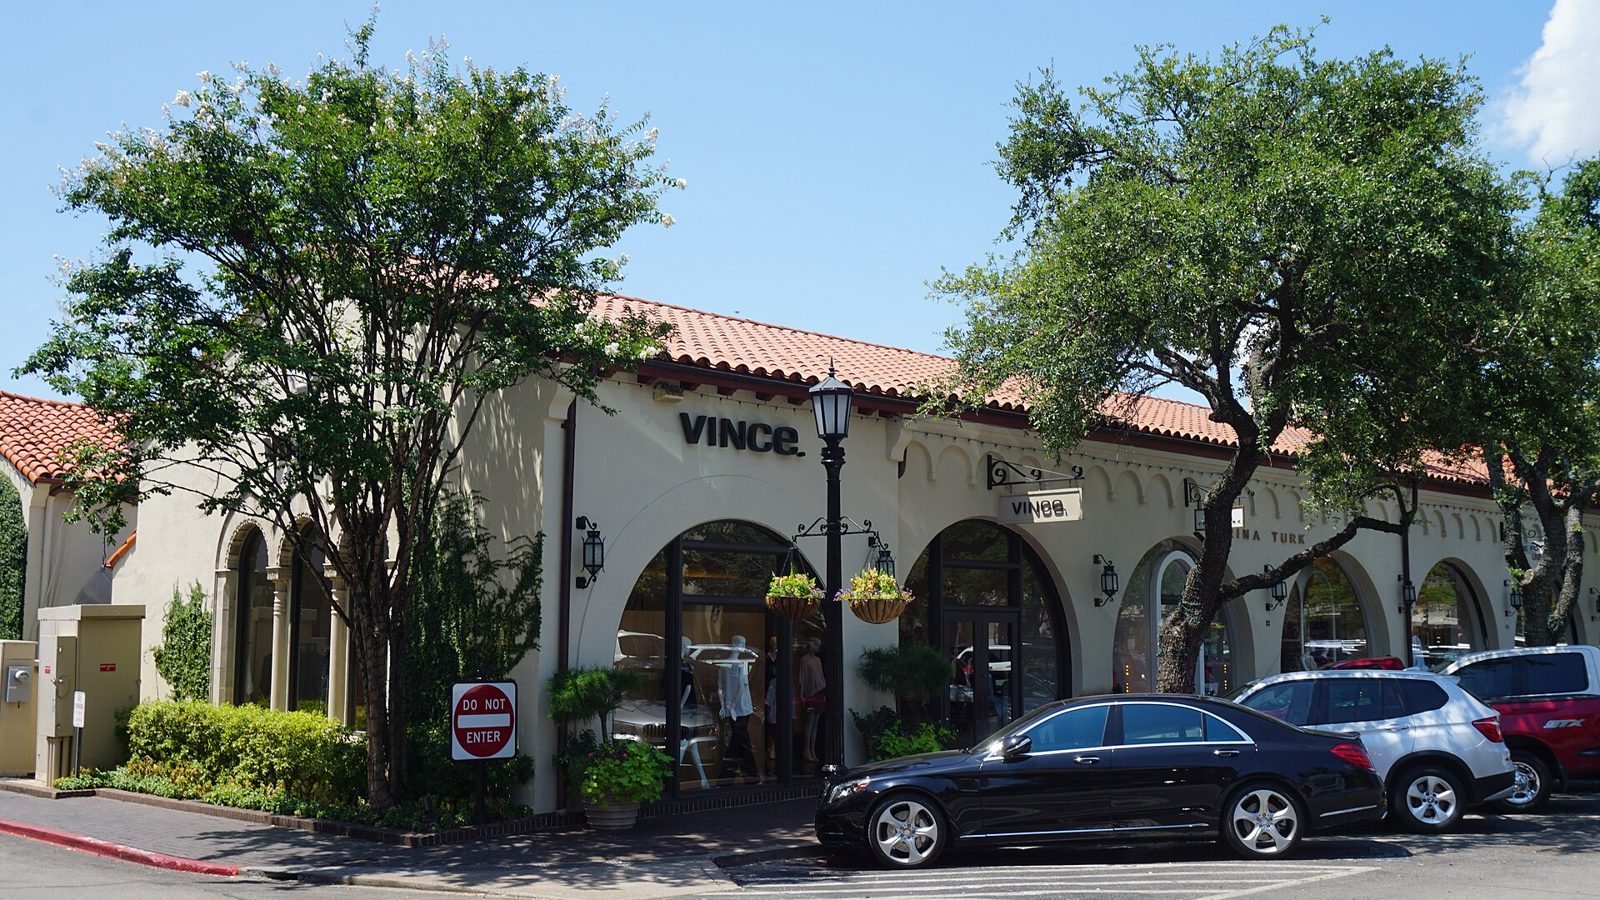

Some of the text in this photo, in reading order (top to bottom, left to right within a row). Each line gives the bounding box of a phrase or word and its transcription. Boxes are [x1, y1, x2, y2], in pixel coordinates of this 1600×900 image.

[1233, 528, 1306, 545] INA TURK
[463, 698, 506, 711] DO NOT
[466, 730, 501, 744] ENTER
